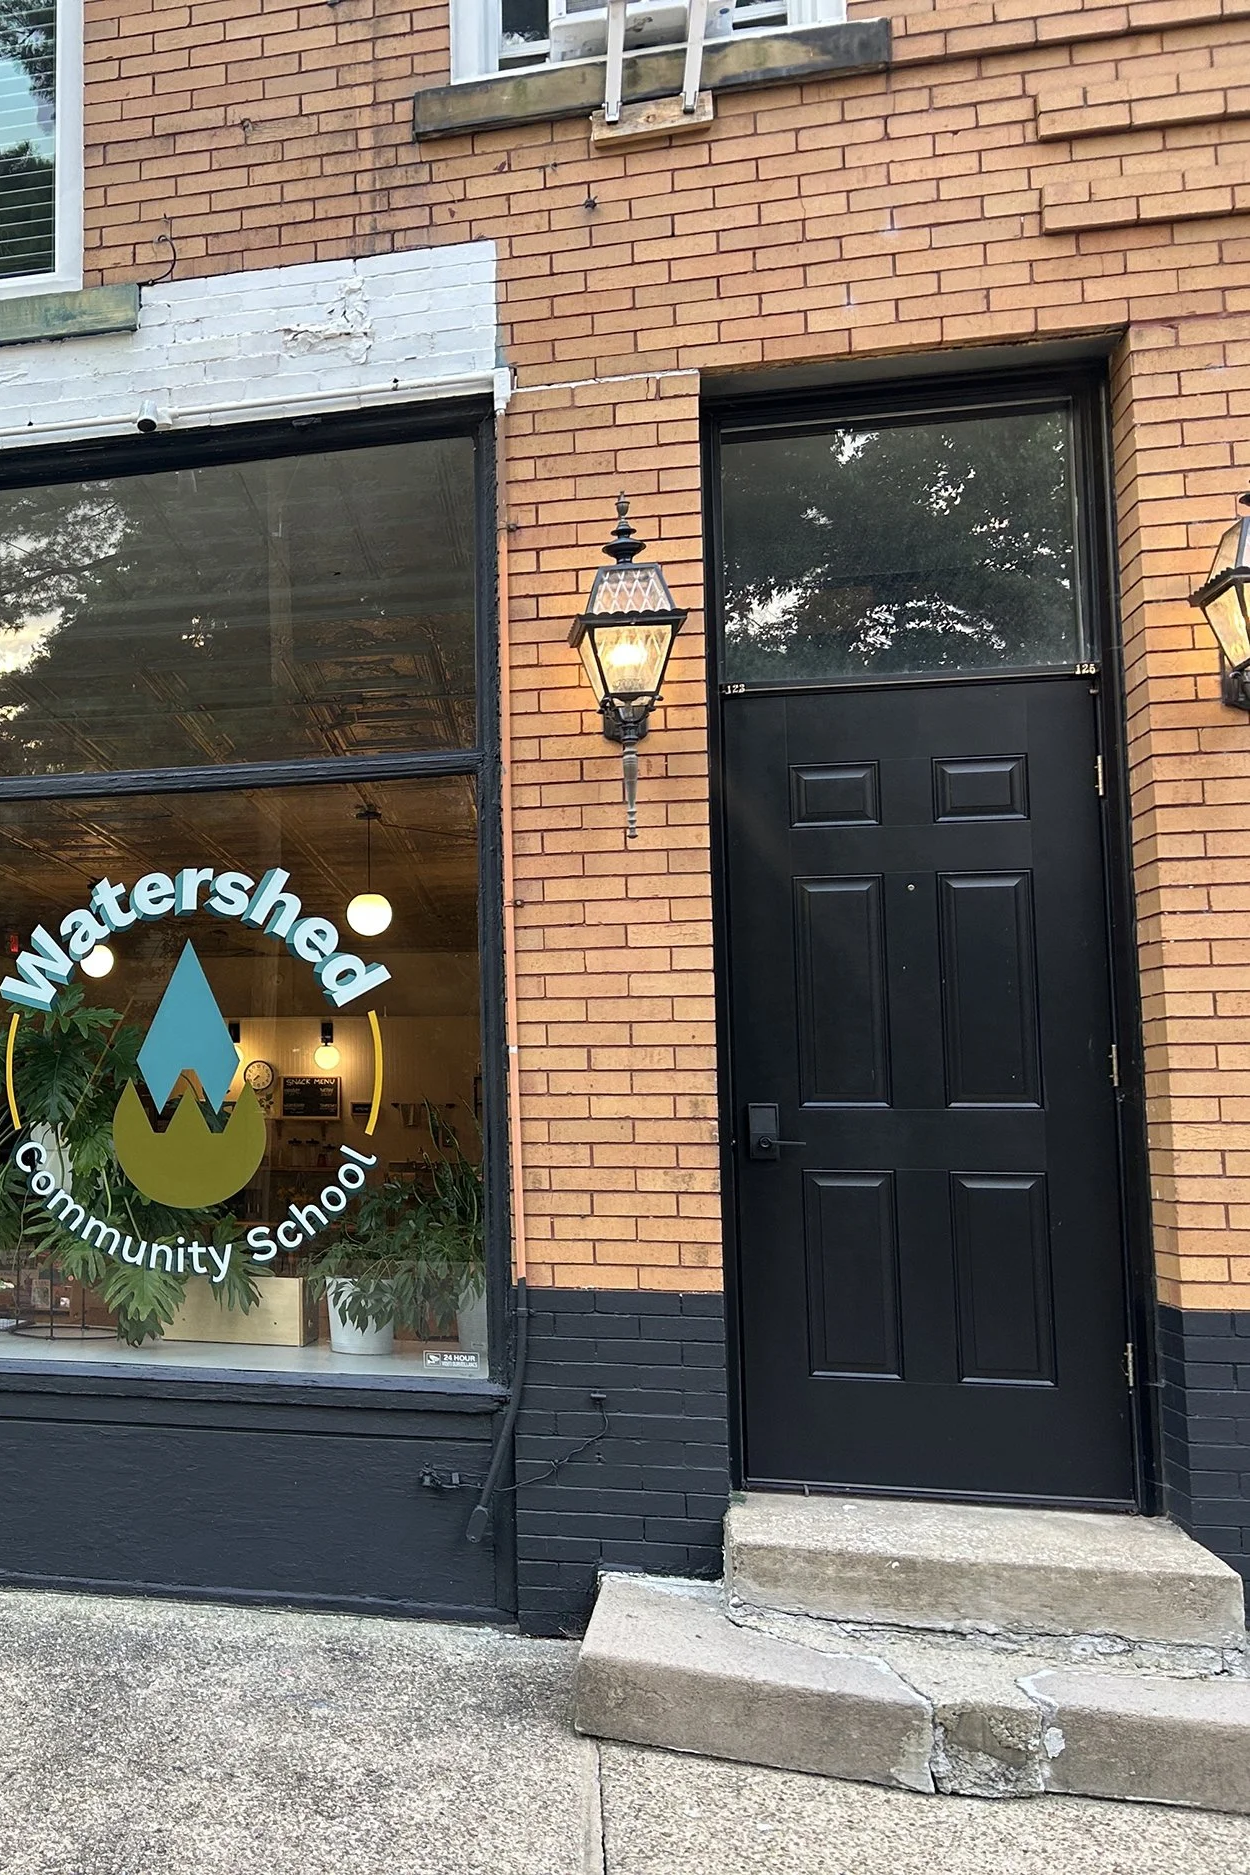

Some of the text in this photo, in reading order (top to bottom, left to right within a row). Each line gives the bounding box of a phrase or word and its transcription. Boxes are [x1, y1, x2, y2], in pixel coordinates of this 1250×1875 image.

[725, 683, 746, 694] 123
[1075, 663, 1096, 674] 125
[0, 866, 391, 1012] Watershed
[16, 1141, 378, 1284] Community School
